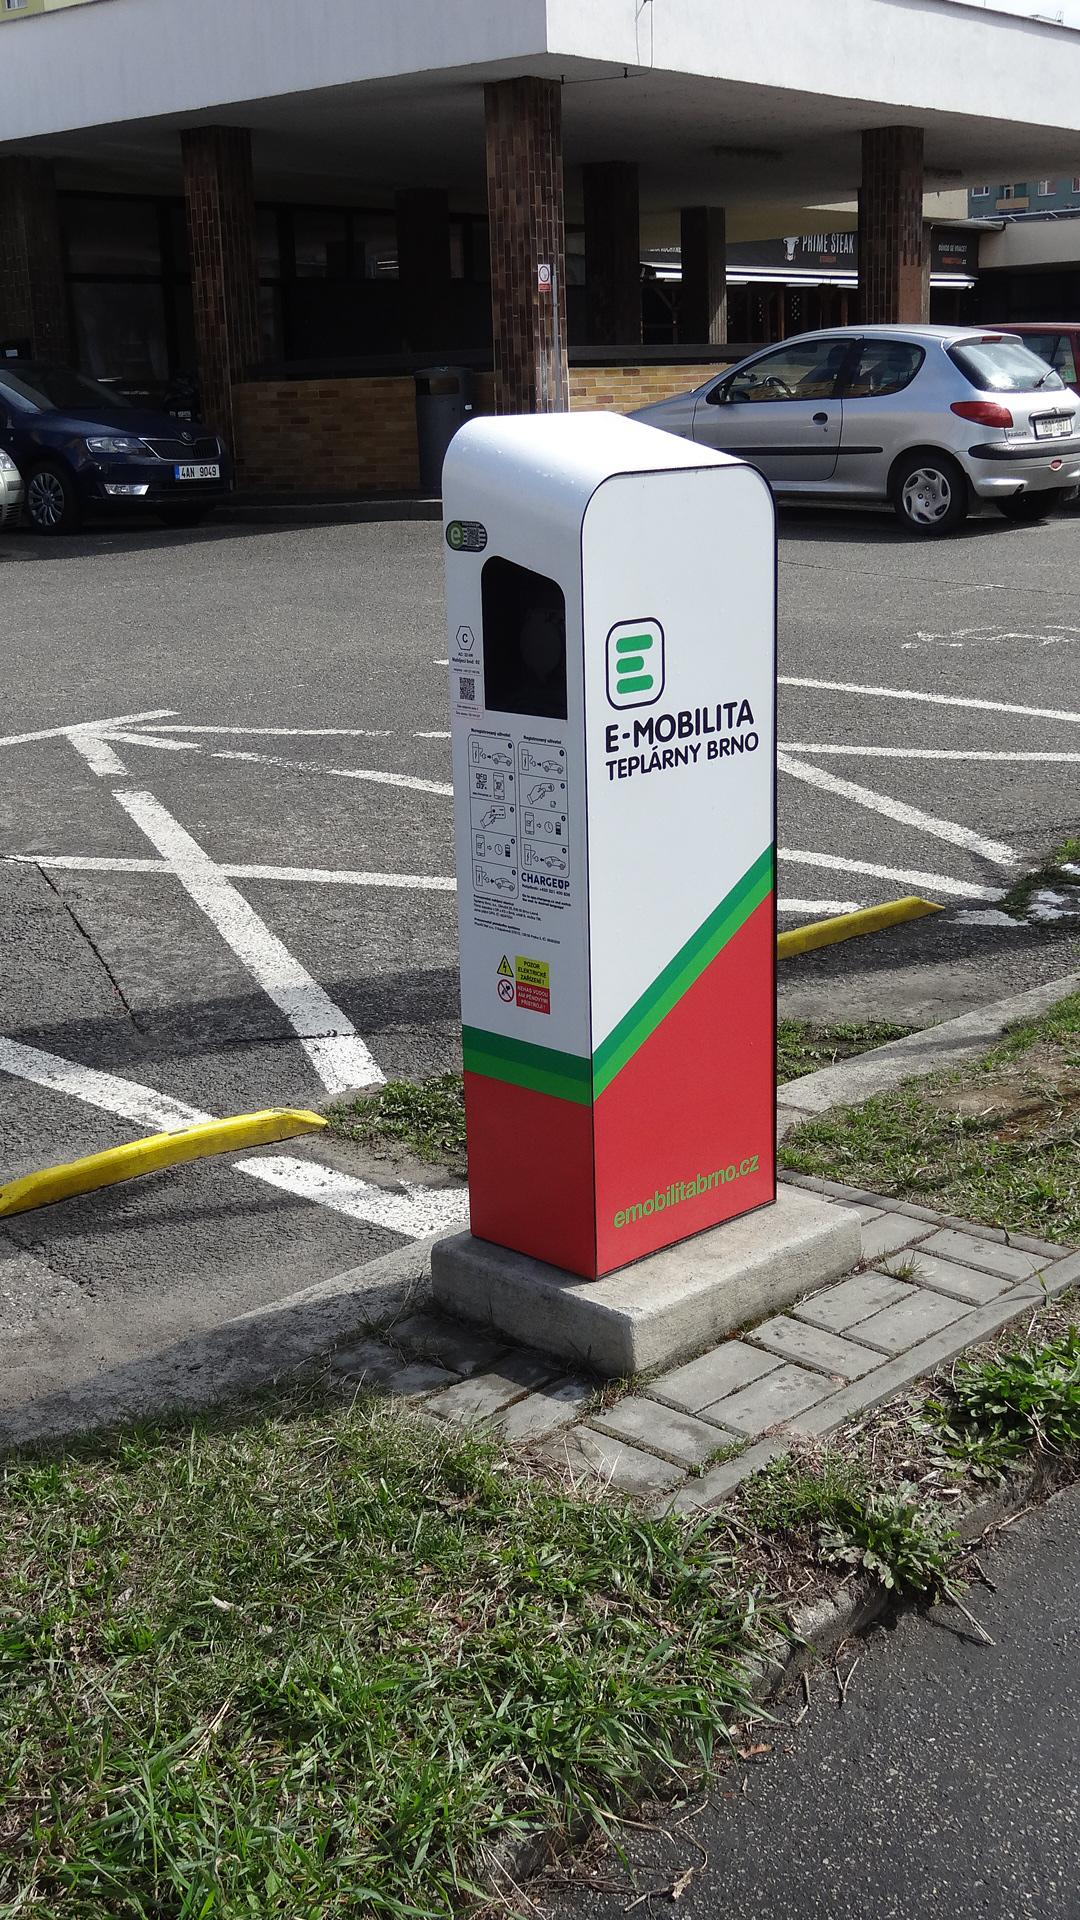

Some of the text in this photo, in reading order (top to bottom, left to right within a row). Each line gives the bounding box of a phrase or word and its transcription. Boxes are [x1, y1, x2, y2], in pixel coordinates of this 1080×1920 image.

[802, 233, 854, 254] PRIME STEAK
[181, 466, 216, 478] 4AN 9049
[462, 633, 469, 643] C
[605, 699, 754, 753] E-MOBILITA
[605, 732, 759, 781] TEPLÁRNY BRNO
[521, 872, 570, 891] CHARGEUP
[613, 1154, 760, 1229] emobilitabrno.cz
